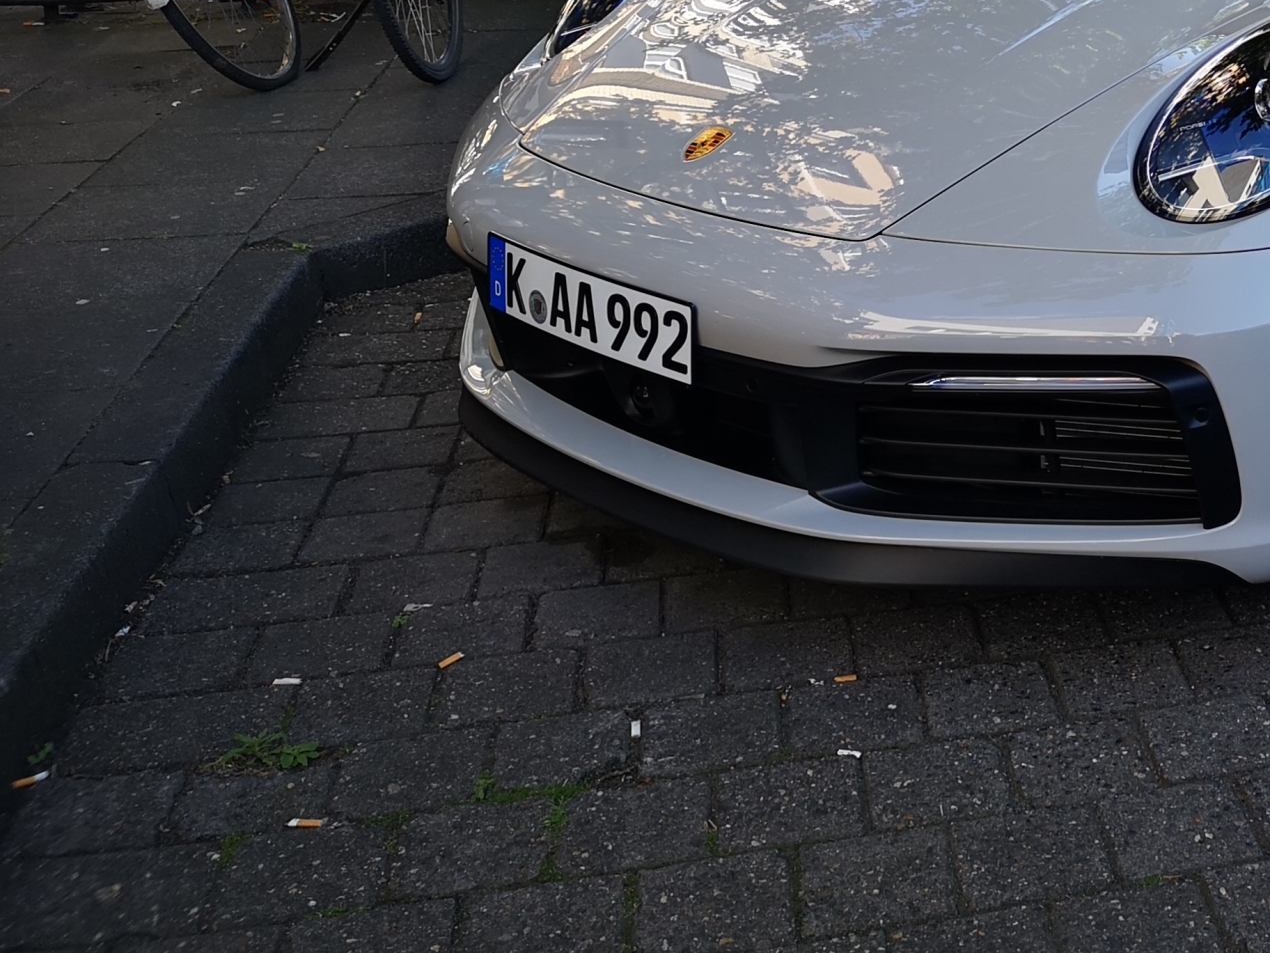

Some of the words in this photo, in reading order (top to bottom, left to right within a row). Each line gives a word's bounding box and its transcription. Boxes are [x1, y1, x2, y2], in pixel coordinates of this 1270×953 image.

[506, 251, 527, 315] K
[549, 271, 598, 344] AA
[606, 292, 689, 375] 992
